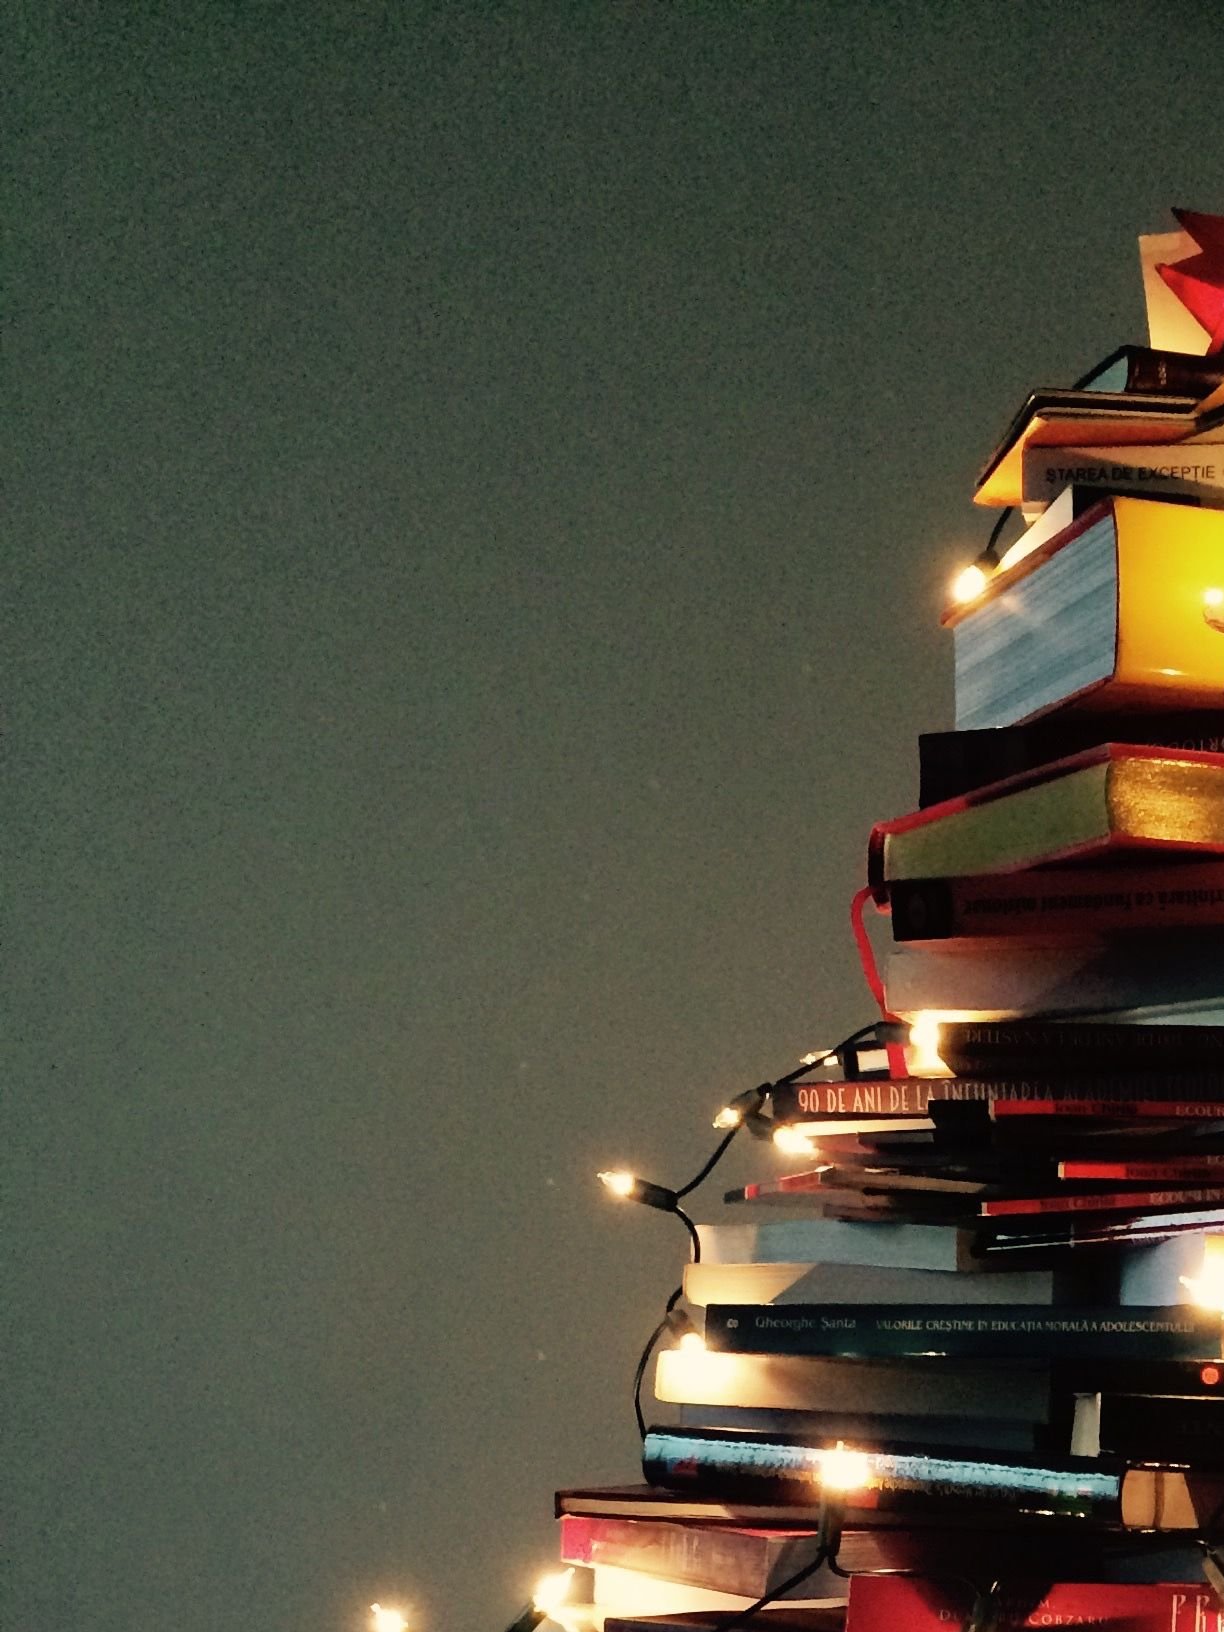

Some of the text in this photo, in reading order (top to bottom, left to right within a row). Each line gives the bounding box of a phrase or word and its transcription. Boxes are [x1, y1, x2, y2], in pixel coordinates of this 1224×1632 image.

[798, 1087, 820, 1114] 90
[826, 1087, 847, 1113] DE
[852, 1086, 886, 1112] ANI
[889, 1085, 910, 1111] DE
[916, 1082, 936, 1110] LA
[755, 1316, 814, 1331] Gheorghe
[875, 1319, 922, 1331] VALORILE
[925, 1319, 975, 1333] CREȘTINE
[991, 1320, 1042, 1333] EDUCAȚIA
[1044, 1319, 1089, 1332] MORALĂ
